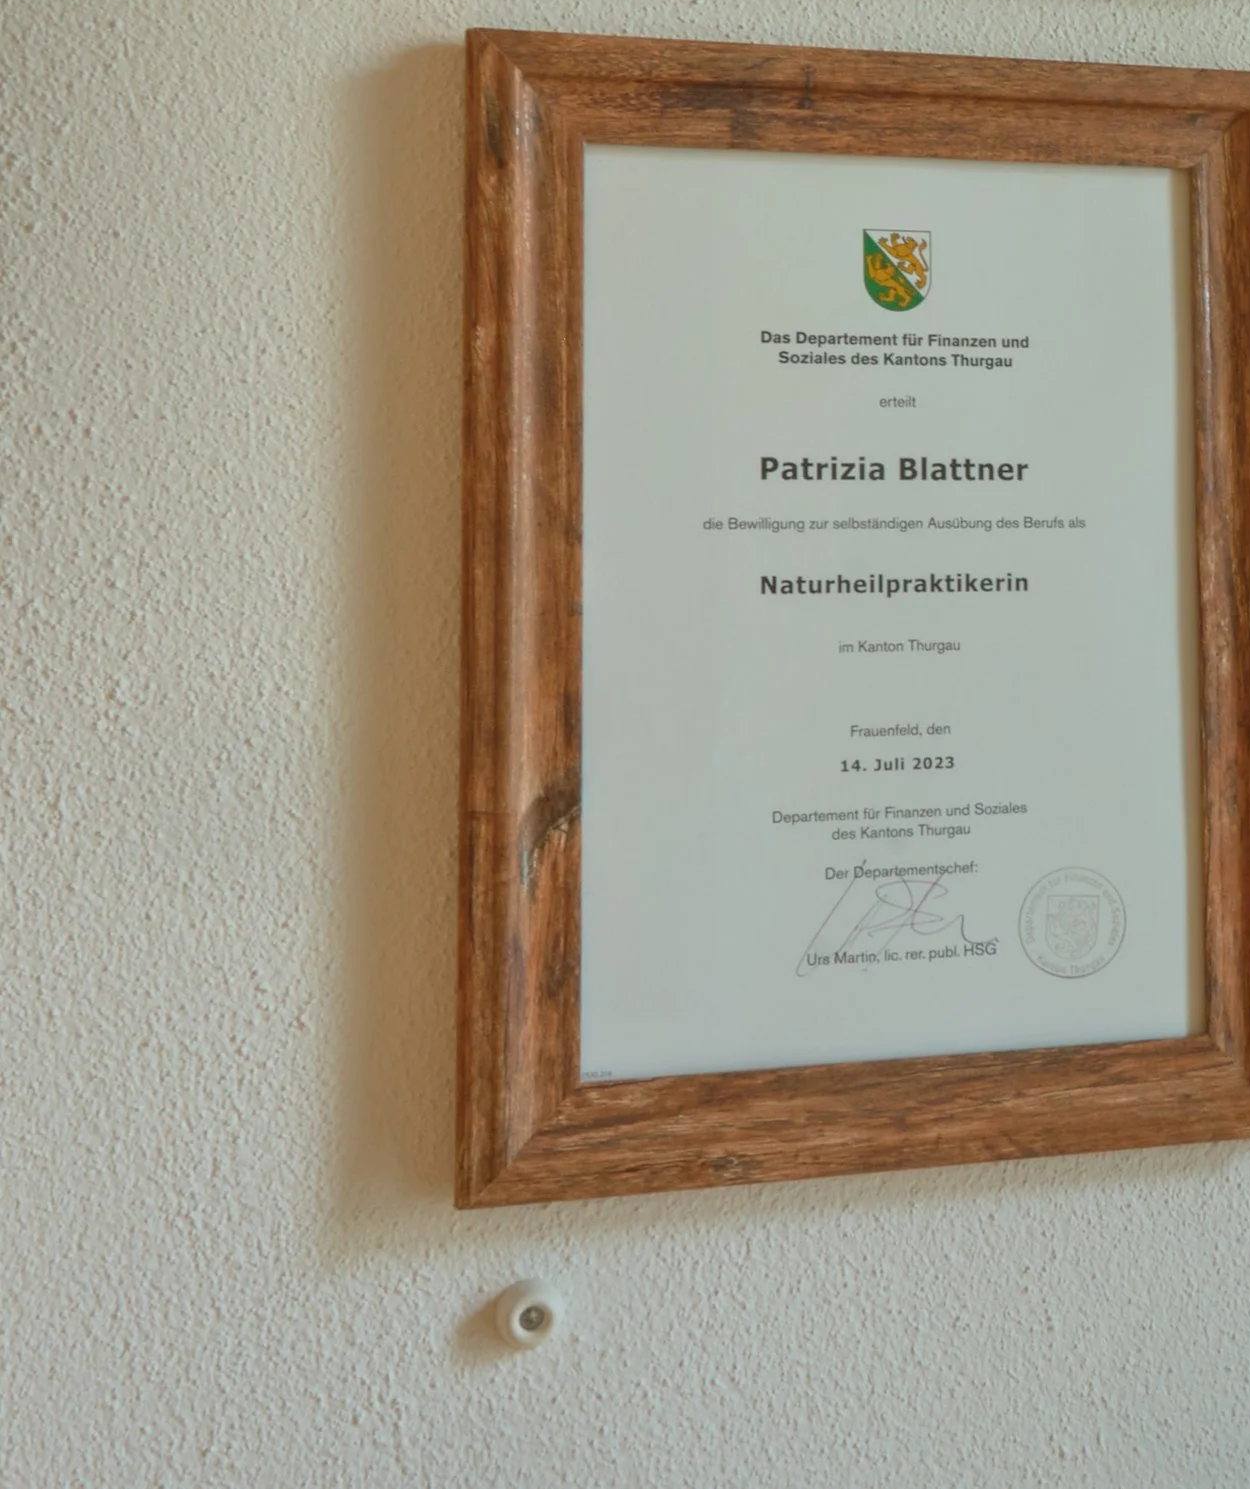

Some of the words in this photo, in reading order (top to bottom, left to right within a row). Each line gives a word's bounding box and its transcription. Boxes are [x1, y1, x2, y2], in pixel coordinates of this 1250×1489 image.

[760, 330, 791, 344] Das
[796, 331, 898, 348] Departement
[902, 333, 924, 347] für
[928, 334, 997, 348] Finanzen
[1001, 336, 1029, 349] und
[778, 350, 847, 365] Soziales
[850, 352, 879, 366] des
[883, 352, 947, 367] Kantons
[950, 353, 1013, 370] Thurgau
[879, 395, 916, 408] erteilt
[760, 456, 885, 481] Patrizia
[899, 456, 1029, 481] Blattner
[703, 517, 724, 530] die
[727, 517, 805, 533] Bewilligung
[809, 520, 829, 530] zur
[832, 517, 924, 533] selbständigen
[927, 516, 993, 532] Ausübung
[995, 517, 1020, 529] des
[1023, 516, 1065, 529] Berufs
[1068, 516, 1086, 529] als
[760, 572, 1028, 598] Naturheilpraktikerin
[838, 641, 854, 653] im
[858, 640, 904, 653] Kanton
[908, 639, 961, 655] Thurgau
[850, 723, 923, 737] Frauenfeld,
[926, 722, 951, 735] den
[841, 759, 867, 772] 14.
[874, 757, 905, 772] Juli
[913, 756, 955, 770] 2023
[772, 809, 859, 826] Departement
[863, 807, 881, 820] für
[884, 806, 942, 819] Finanzen
[945, 803, 971, 817] und
[974, 801, 1028, 816] Soziales
[831, 828, 856, 840] des
[860, 826, 914, 839] Kantons
[917, 823, 971, 839] Thurgau
[825, 867, 849, 880] Der
[853, 861, 978, 880] Departementschef:
[806, 952, 831, 966] Urs
[833, 950, 880, 964] Martin,
[884, 949, 902, 961] lic.
[905, 950, 926, 960] rer.
[928, 945, 960, 962] publ.
[963, 942, 997, 957] HSG
